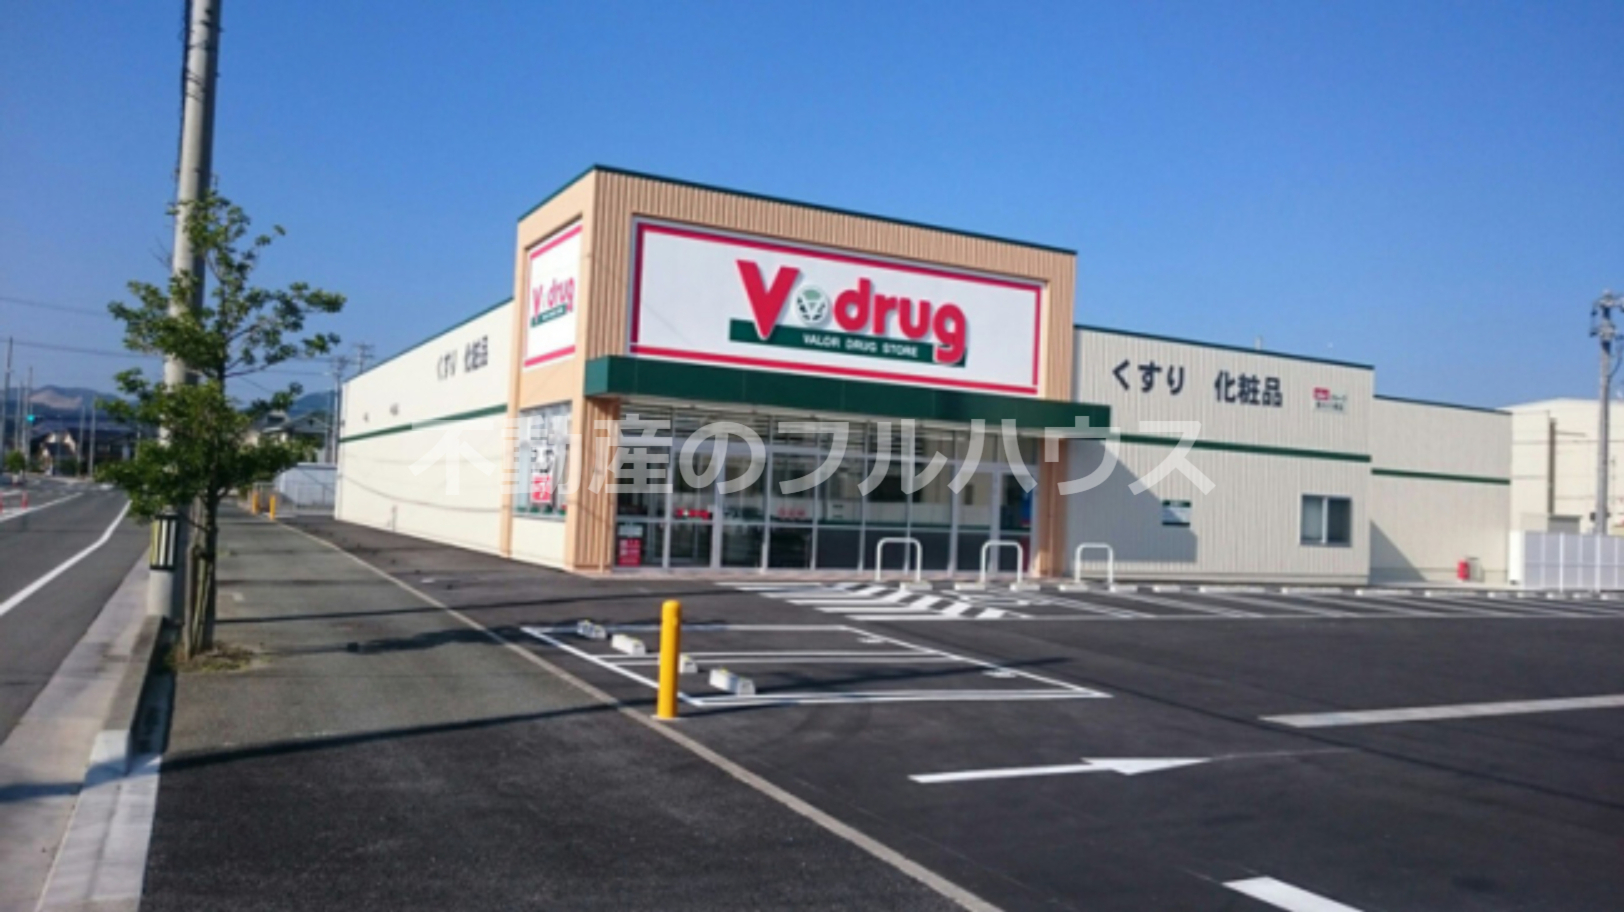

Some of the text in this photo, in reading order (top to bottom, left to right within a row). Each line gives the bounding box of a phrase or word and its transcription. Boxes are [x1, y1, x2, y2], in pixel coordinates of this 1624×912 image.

[736, 260, 967, 364] V drug
[802, 333, 919, 358] VALOR DRUG STORE
[1112, 359, 1184, 395] くすり
[1214, 370, 1283, 407] 化粧品
